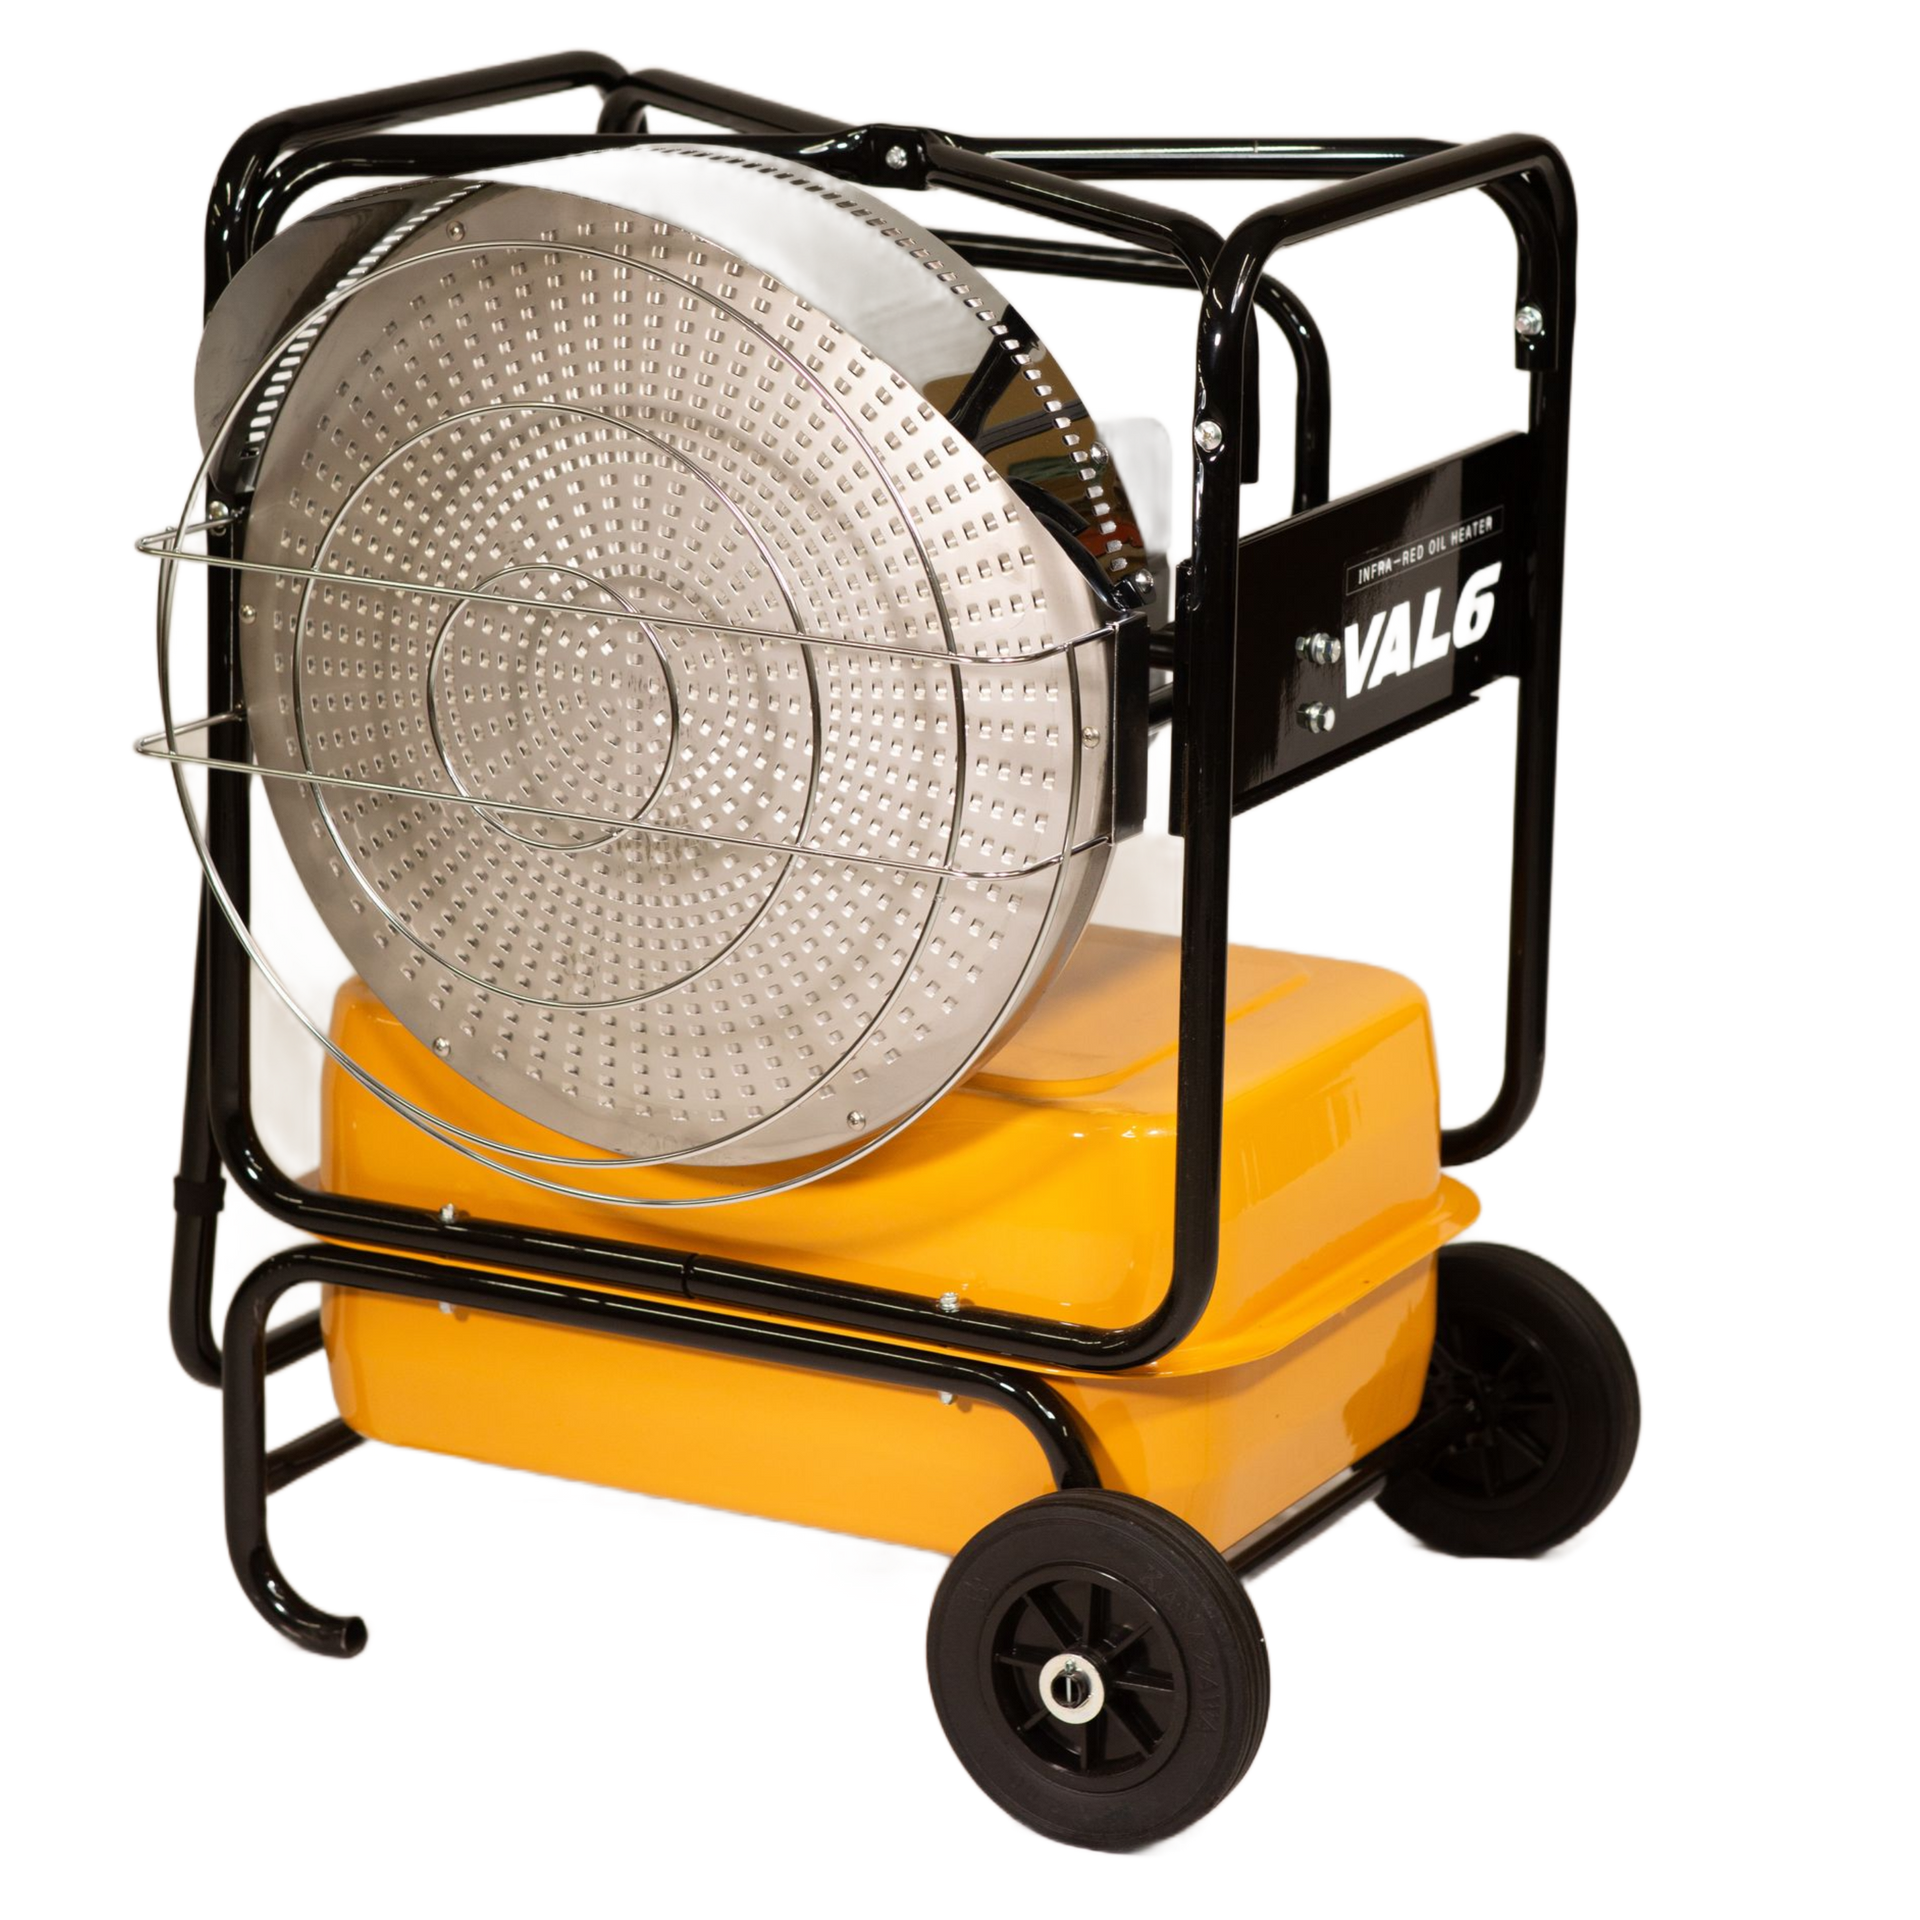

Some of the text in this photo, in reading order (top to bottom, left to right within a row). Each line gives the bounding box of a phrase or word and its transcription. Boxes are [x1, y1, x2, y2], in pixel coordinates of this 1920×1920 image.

[1358, 515, 1493, 585] INFRA-RED OIL HEATER
[1344, 562, 1502, 699] VAL6
